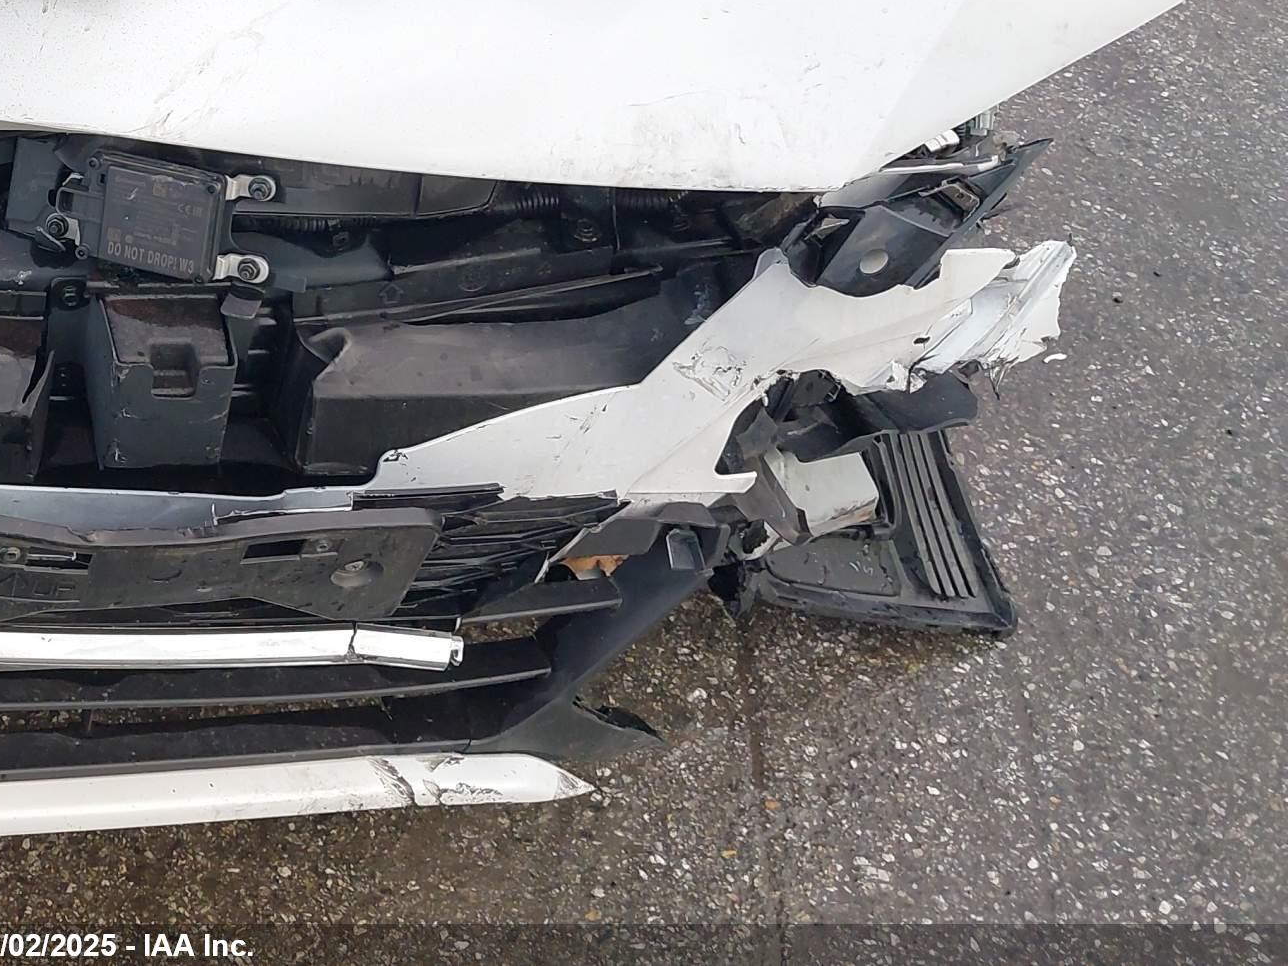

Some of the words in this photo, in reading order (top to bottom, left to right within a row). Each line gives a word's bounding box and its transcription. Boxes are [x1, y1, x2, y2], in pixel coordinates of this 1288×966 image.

[107, 242, 122, 256] DO
[124, 245, 145, 261] NOT
[147, 251, 178, 271] DROP!
[179, 257, 195, 275] W3
